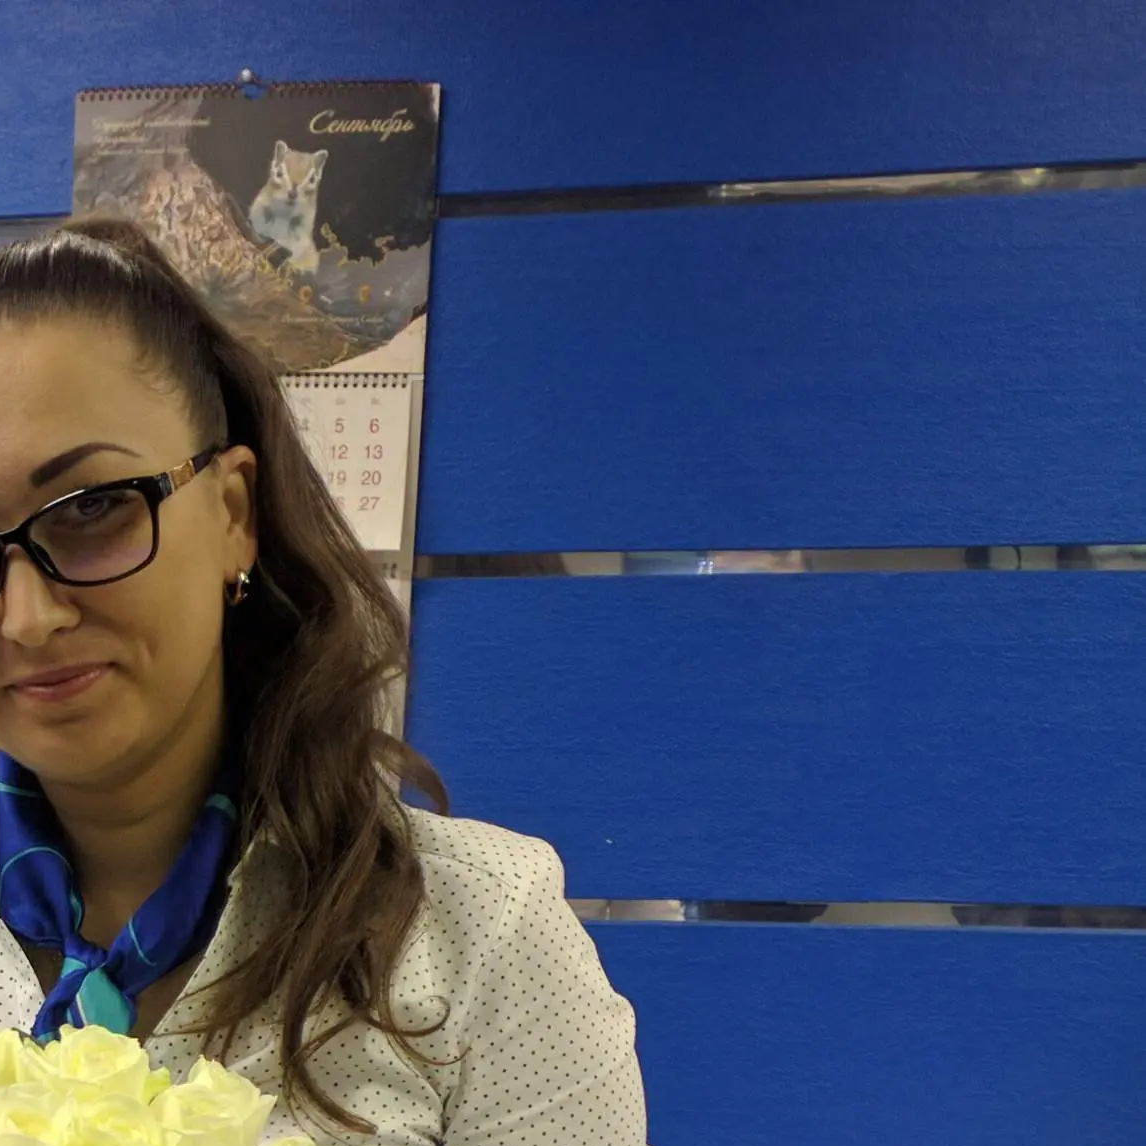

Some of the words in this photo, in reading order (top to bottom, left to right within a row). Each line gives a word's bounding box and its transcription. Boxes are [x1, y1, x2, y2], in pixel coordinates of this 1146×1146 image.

[309, 107, 415, 142] Сентябрь
[334, 417, 346, 434] 5
[369, 417, 380, 434] 6
[330, 444, 349, 460] 12
[365, 444, 383, 460] 13
[328, 470, 347, 486] 19
[360, 470, 382, 486] 20
[358, 496, 381, 511] 27
